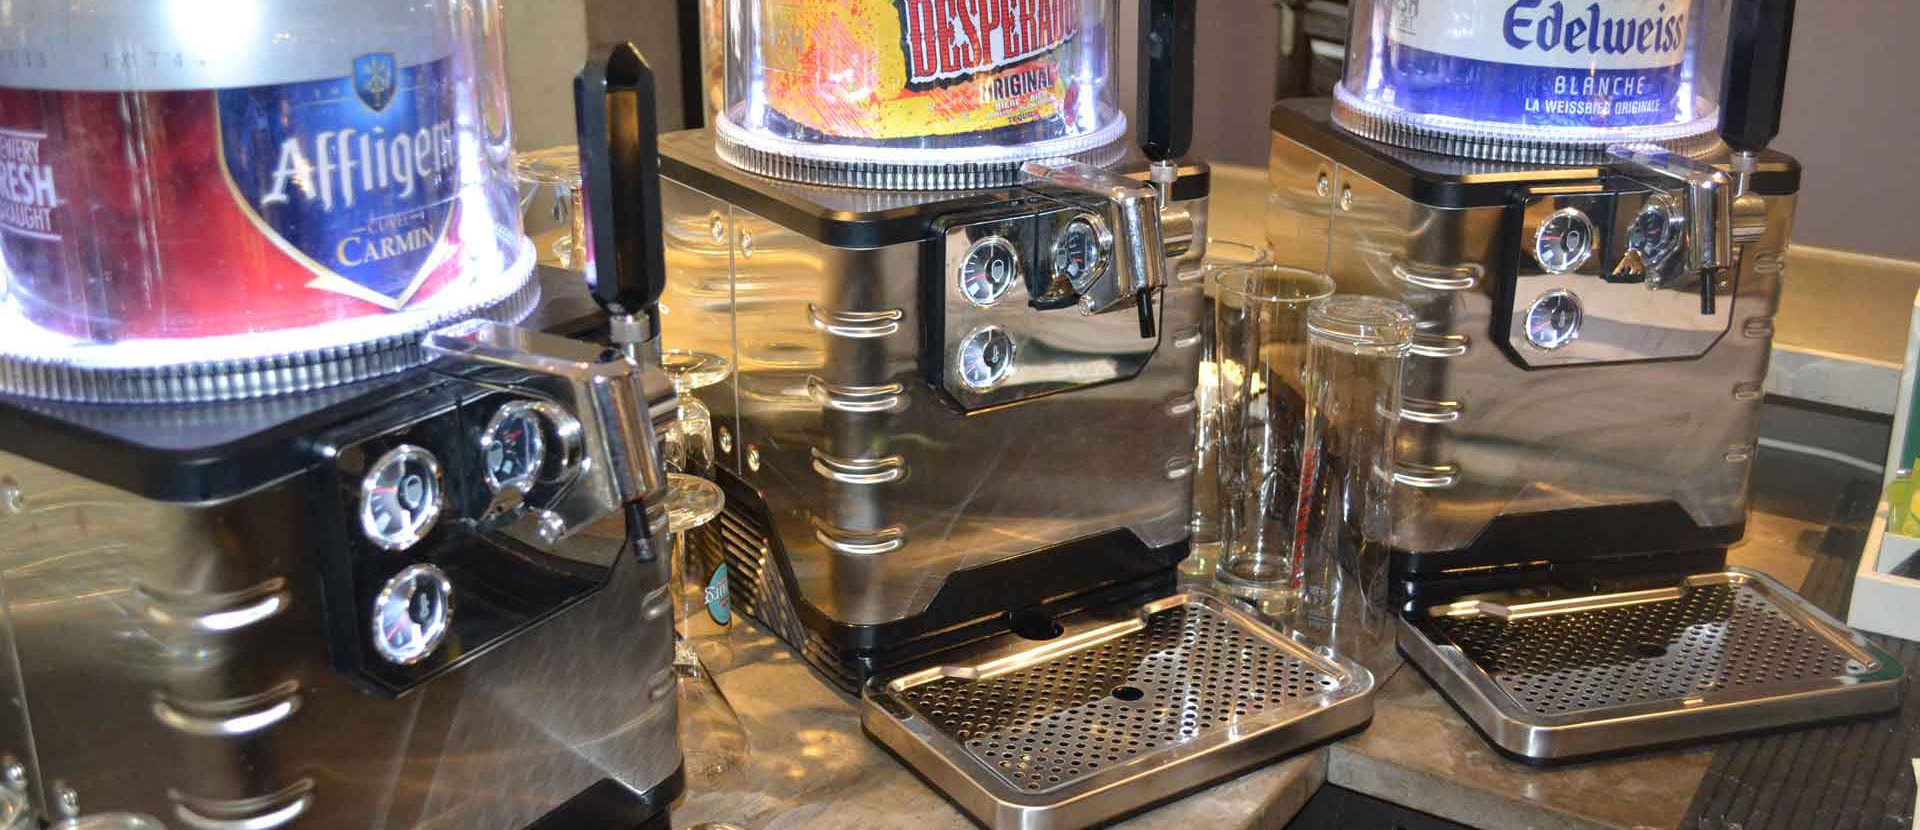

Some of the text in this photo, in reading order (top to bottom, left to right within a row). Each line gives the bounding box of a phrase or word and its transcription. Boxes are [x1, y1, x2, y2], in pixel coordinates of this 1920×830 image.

[908, 0, 1080, 78] DESPERADO
[1503, 0, 1684, 54] Edelweiss
[1524, 97, 1540, 113] LA
[1615, 99, 1660, 114] ORIGINALE
[1554, 75, 1647, 96] BLANCHE
[336, 223, 434, 267] CARMIN
